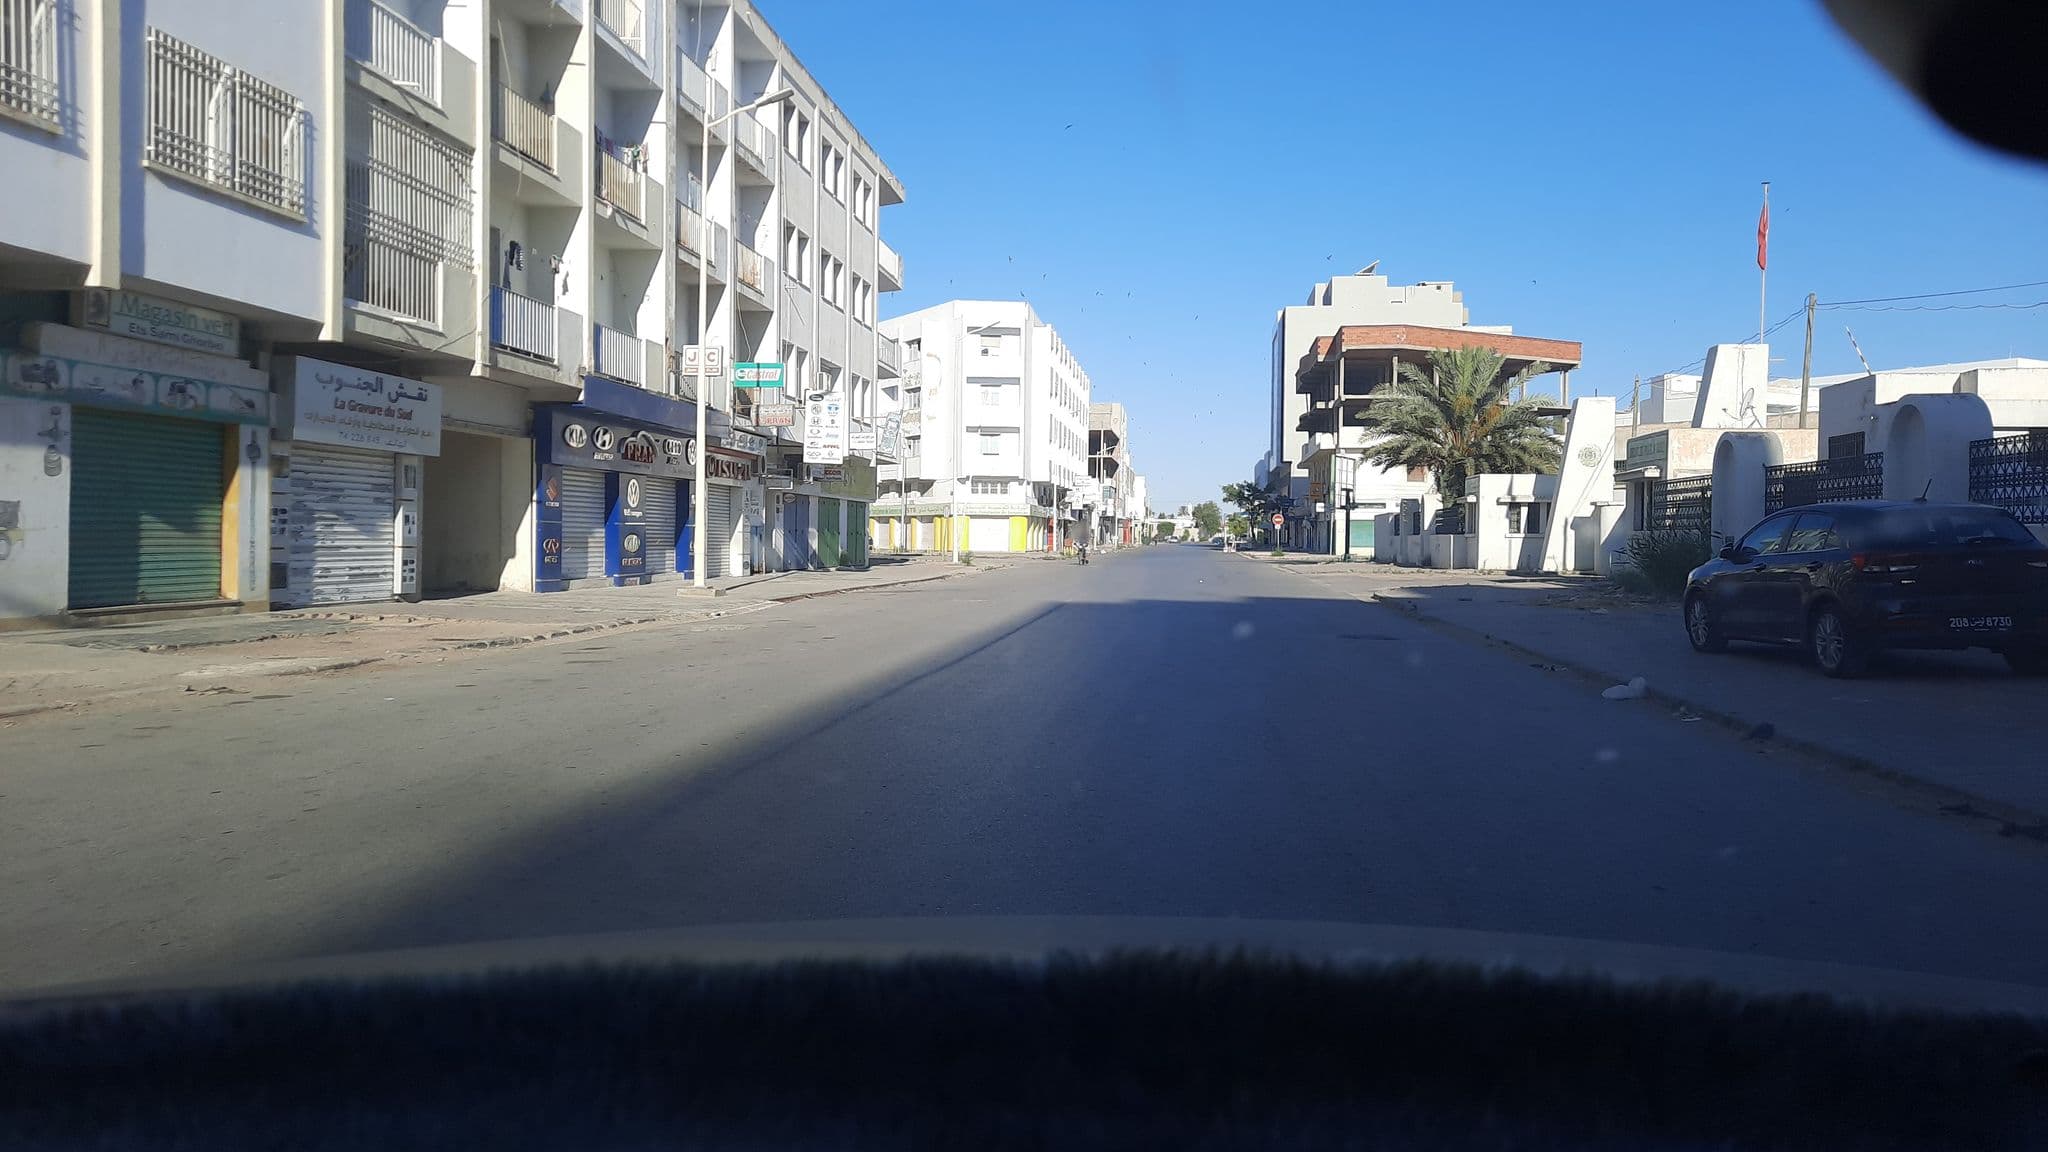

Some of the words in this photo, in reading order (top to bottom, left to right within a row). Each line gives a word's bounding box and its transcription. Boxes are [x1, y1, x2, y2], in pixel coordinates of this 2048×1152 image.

[120, 293, 198, 329] Magasin
[129, 323, 147, 336] Ets
[688, 351, 716, 363] JC
[315, 372, 384, 397] الجنوب
[746, 370, 778, 380] Castrol
[388, 383, 428, 404] نقش
[334, 397, 346, 410] La
[347, 399, 384, 416] Gravure
[385, 405, 396, 418] du
[397, 408, 413, 421] Sud
